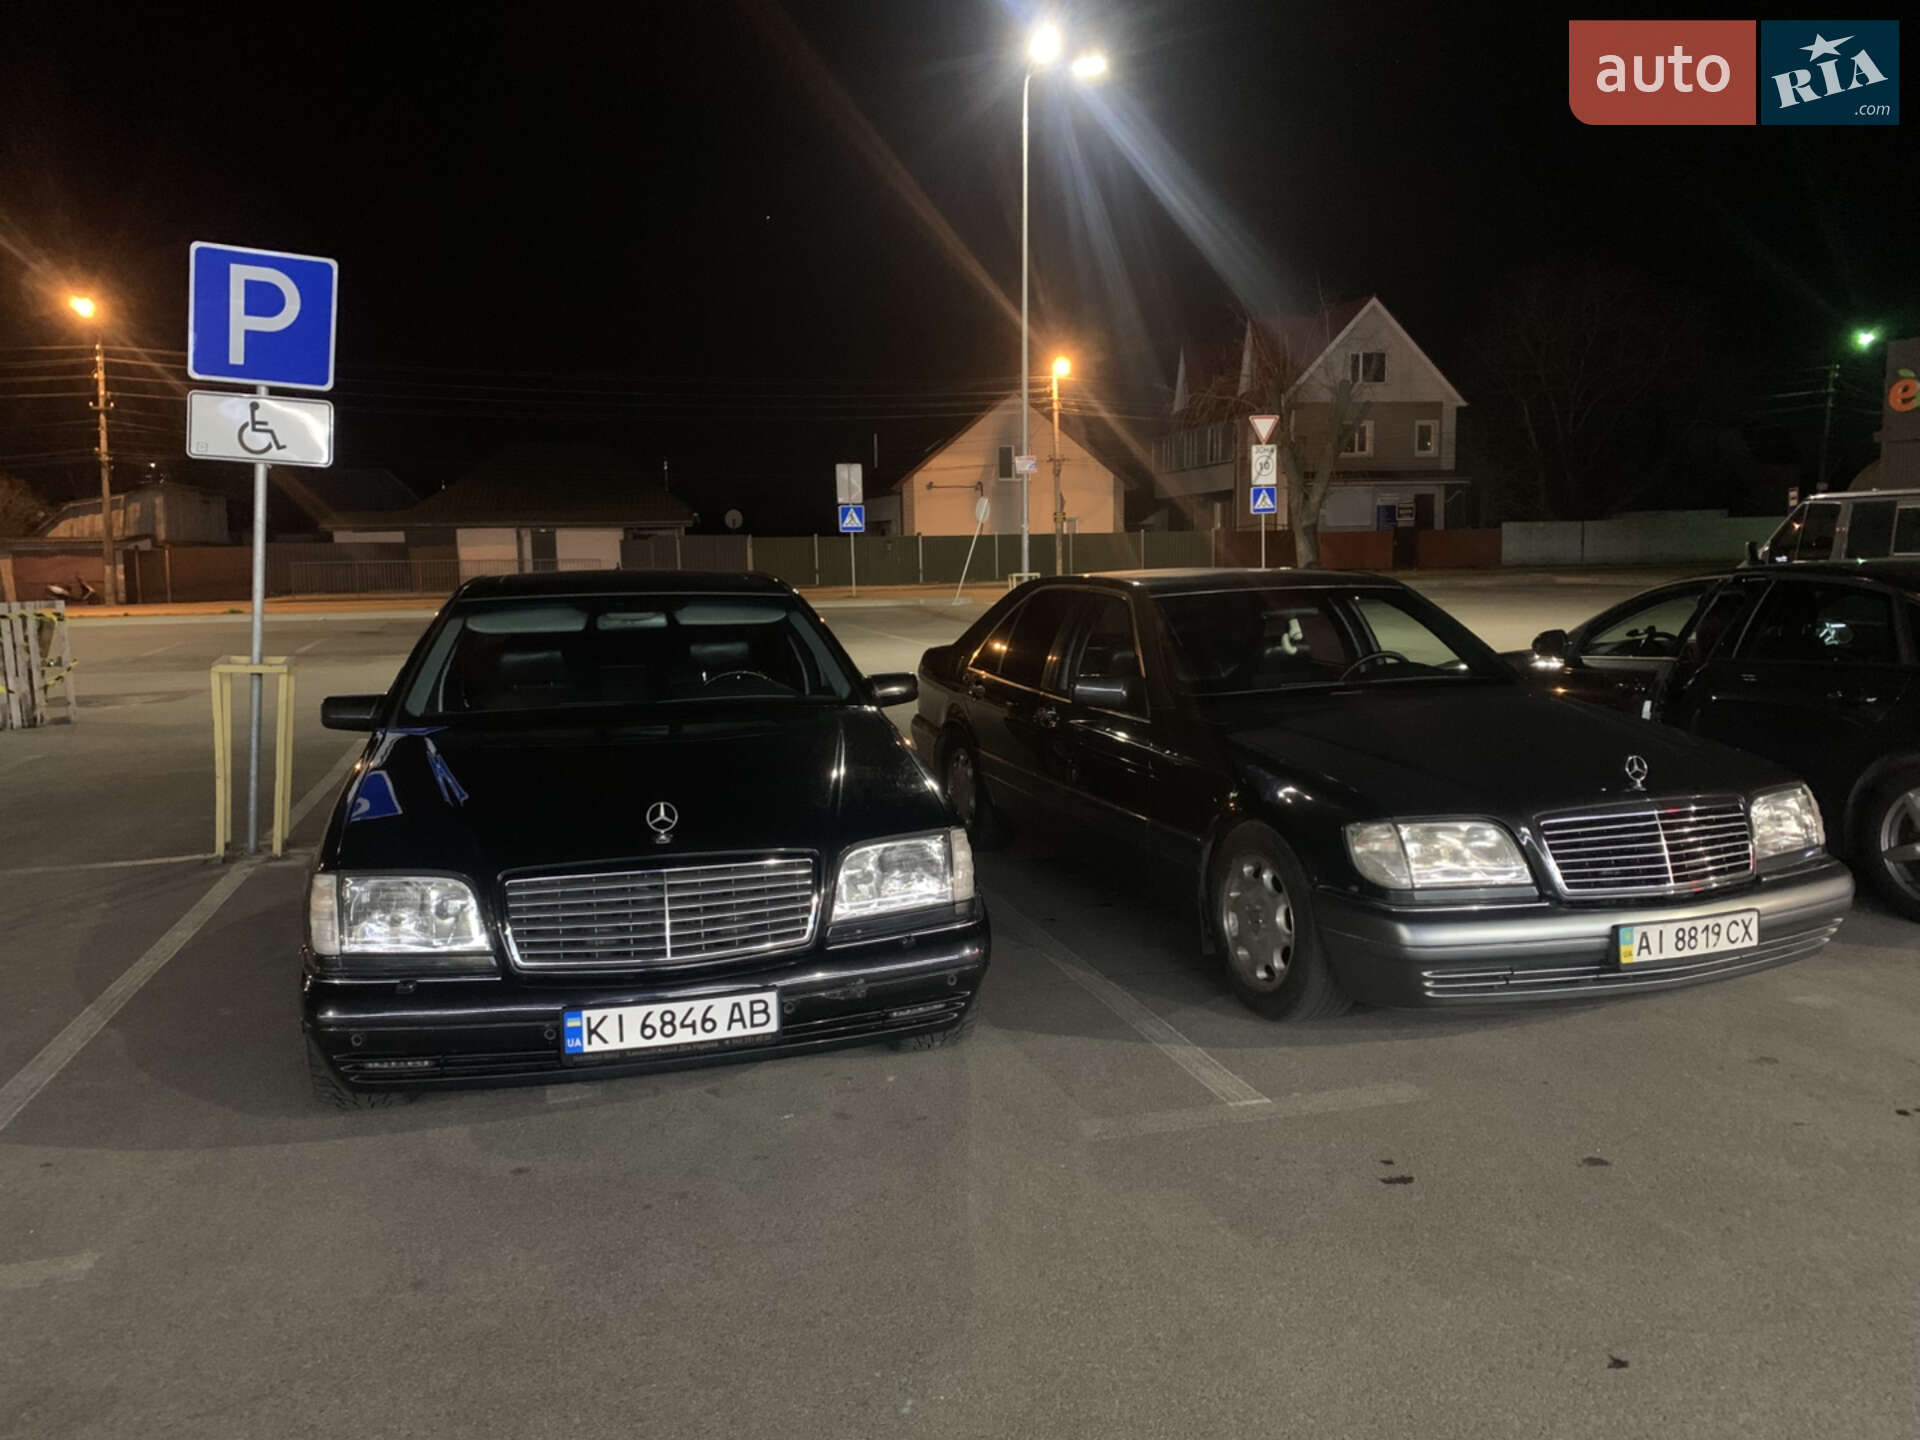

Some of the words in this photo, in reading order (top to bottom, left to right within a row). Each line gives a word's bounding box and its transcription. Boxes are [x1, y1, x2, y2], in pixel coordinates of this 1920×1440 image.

[228, 263, 301, 366] P
[1636, 929, 1663, 957] AI
[1674, 922, 1721, 952] 8819
[1726, 917, 1753, 945] CX
[567, 1037, 582, 1048] UA
[586, 1013, 624, 1046] KI
[640, 1004, 717, 1041] 6846
[727, 999, 771, 1032] AB
